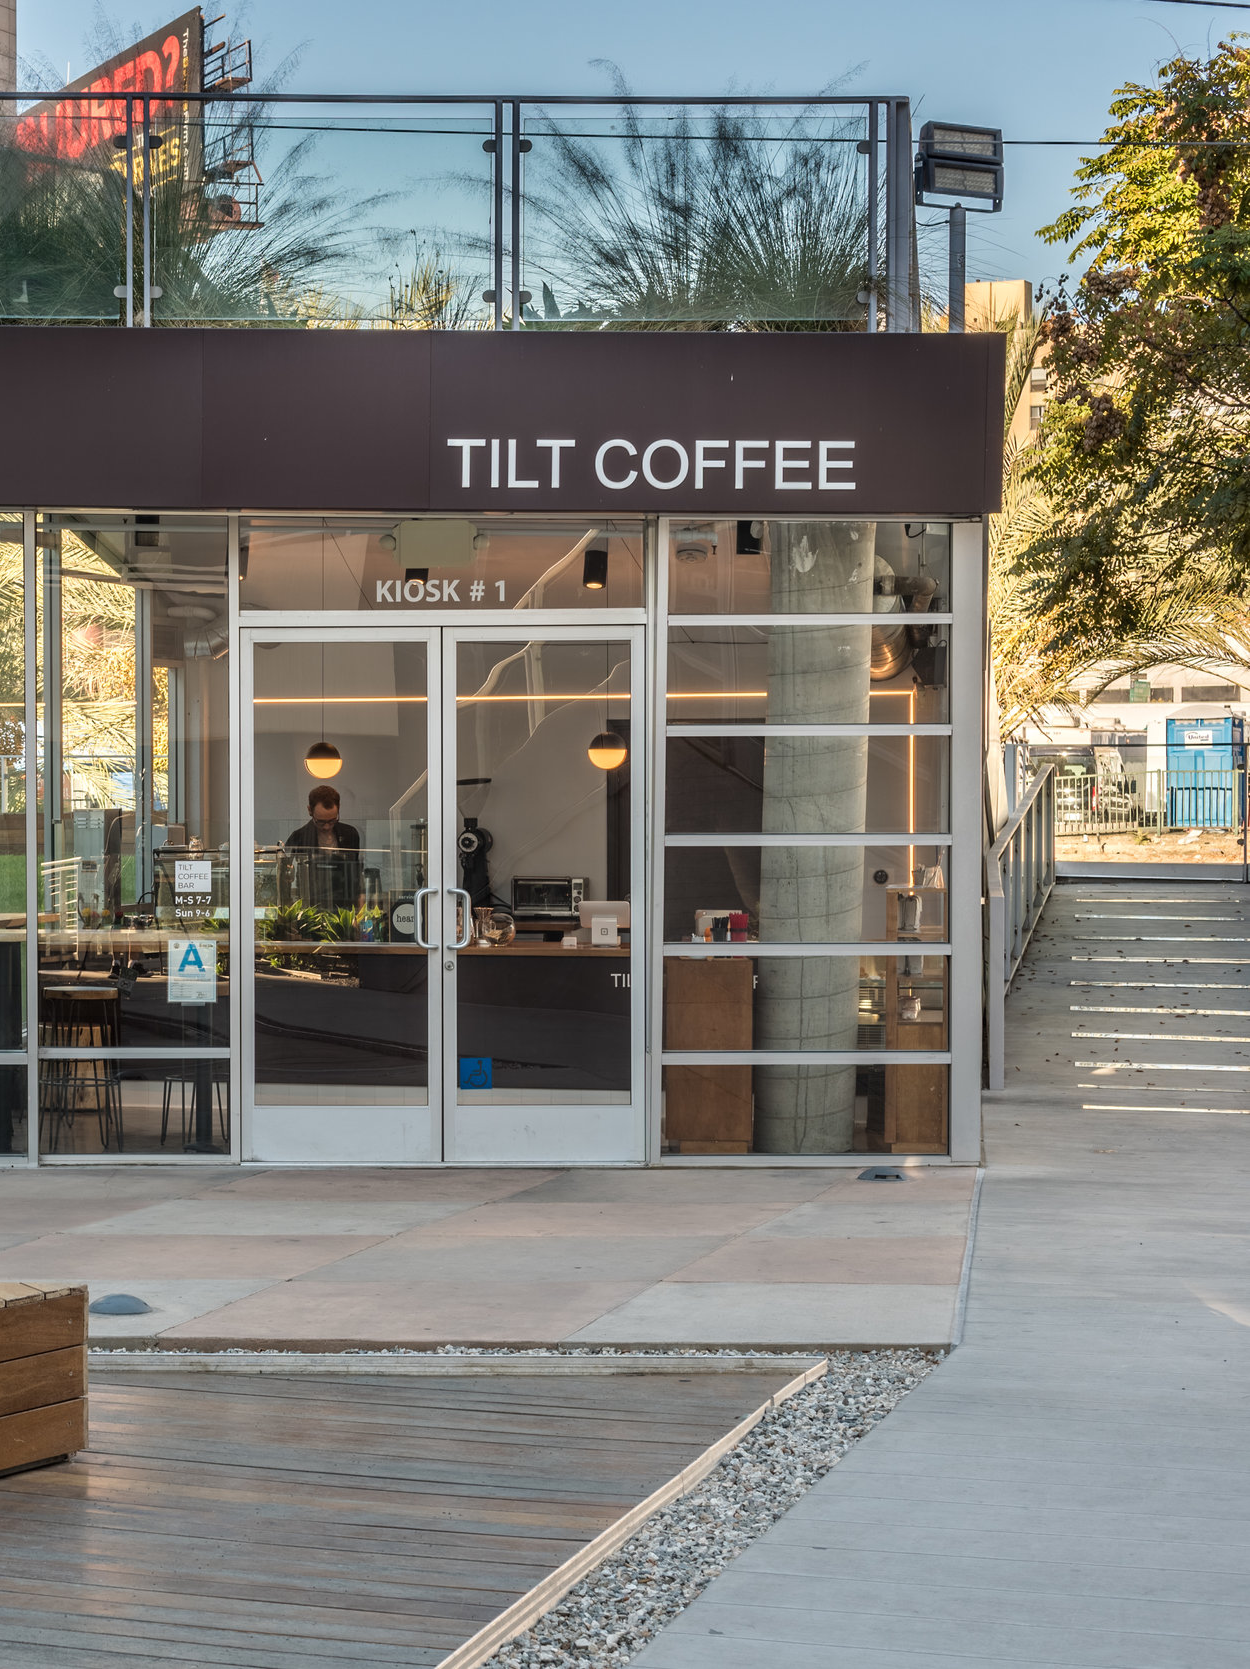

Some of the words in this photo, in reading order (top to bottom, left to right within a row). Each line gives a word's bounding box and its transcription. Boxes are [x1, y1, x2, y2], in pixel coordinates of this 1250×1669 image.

[446, 438, 576, 488] TILT
[594, 438, 857, 490] COFFEE
[375, 579, 461, 603] KIOSK
[469, 580, 486, 602] #
[494, 580, 506, 602] 1
[178, 863, 193, 871] TILT
[177, 872, 209, 880] COFFEE
[175, 895, 194, 905] M-S
[195, 895, 212, 905] 7-7
[175, 908, 194, 918] Sun
[195, 909, 211, 918] 9-6
[396, 914, 415, 923] hear
[178, 943, 206, 973] A
